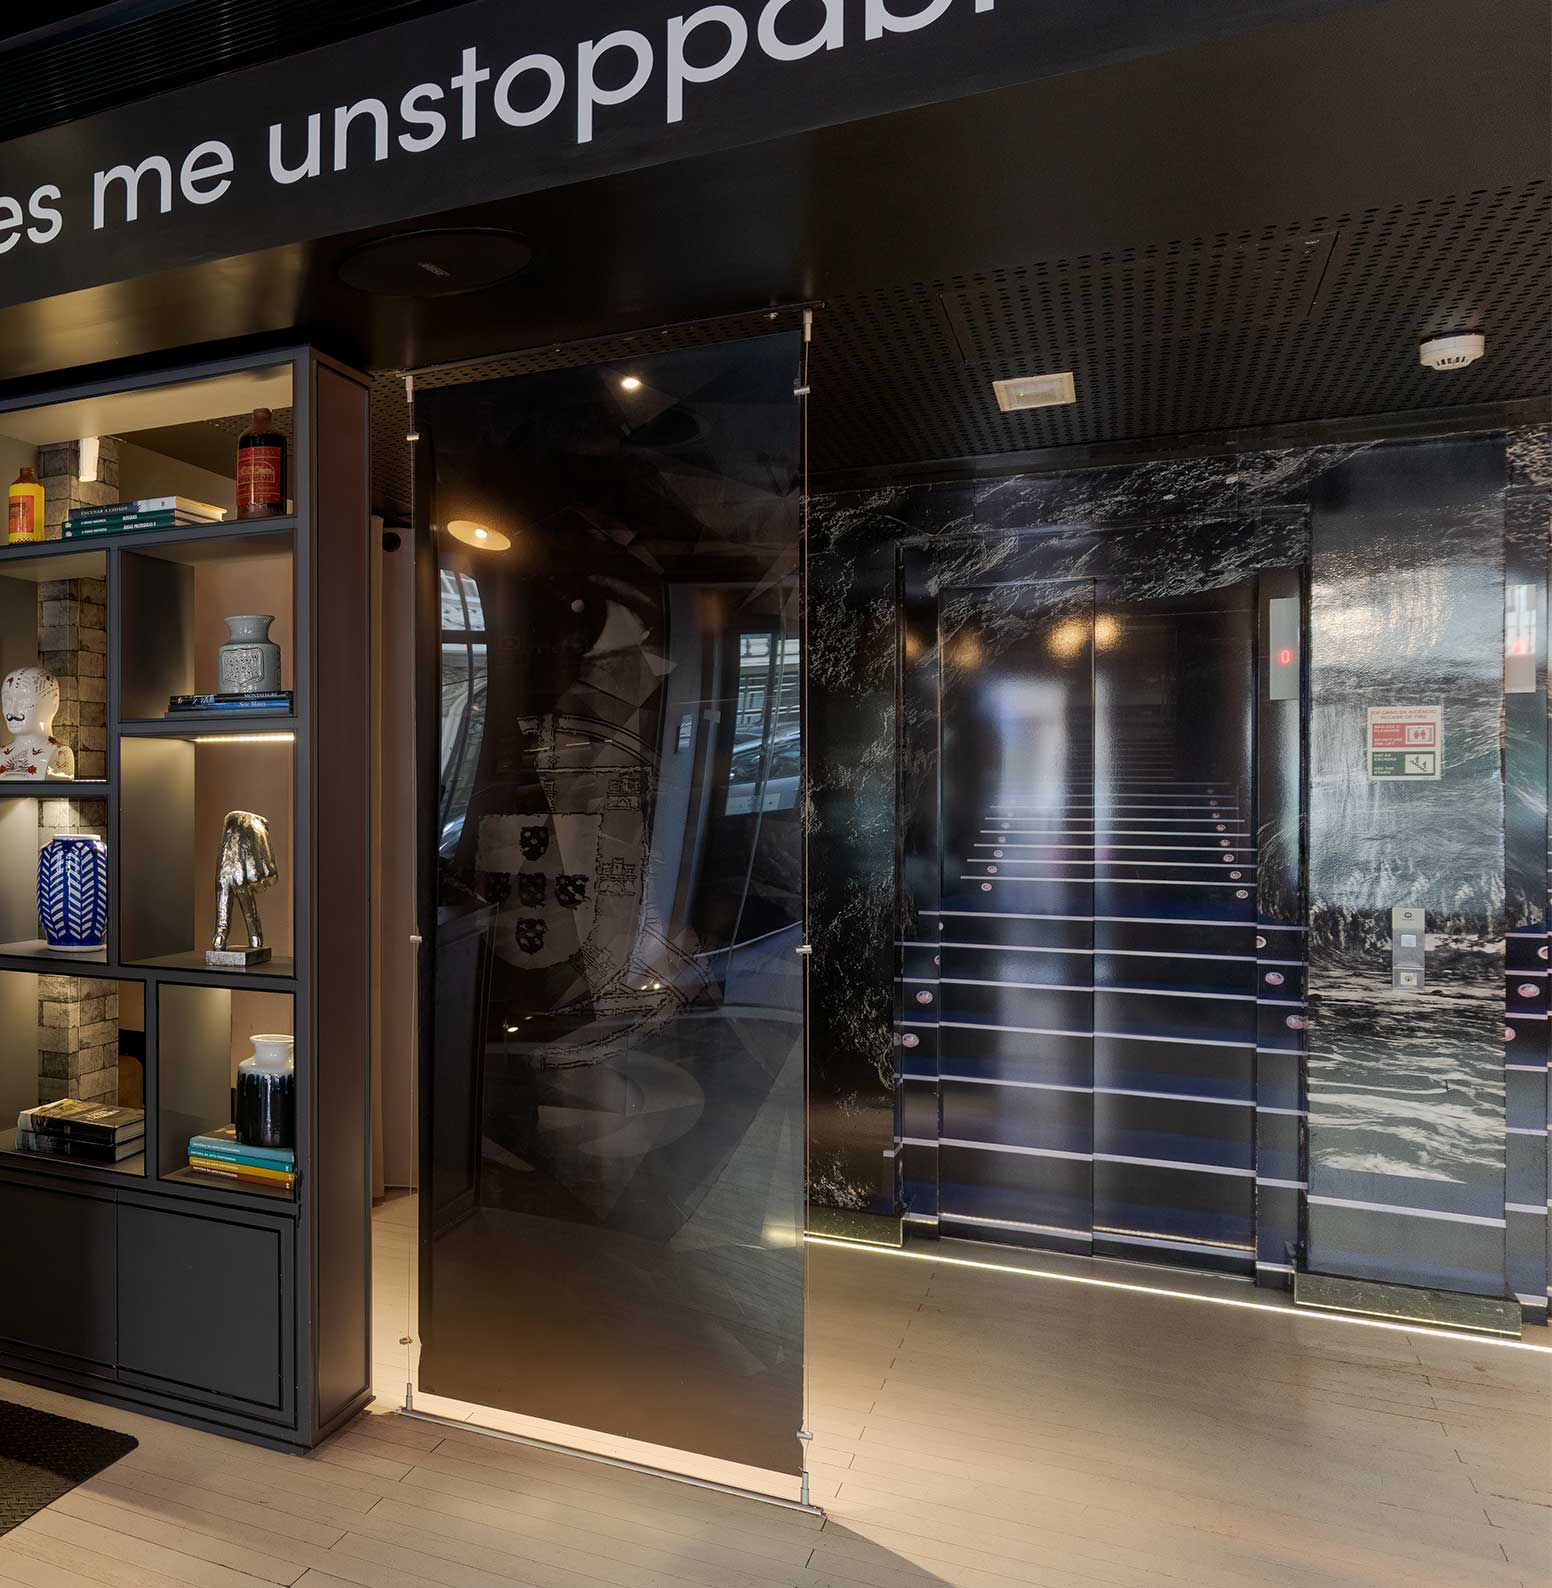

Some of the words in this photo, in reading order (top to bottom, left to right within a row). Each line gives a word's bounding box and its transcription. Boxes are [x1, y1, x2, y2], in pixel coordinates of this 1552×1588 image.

[93, 140, 234, 231] me
[269, 0, 995, 184] unstoppa
[1280, 649, 1291, 664] 0
